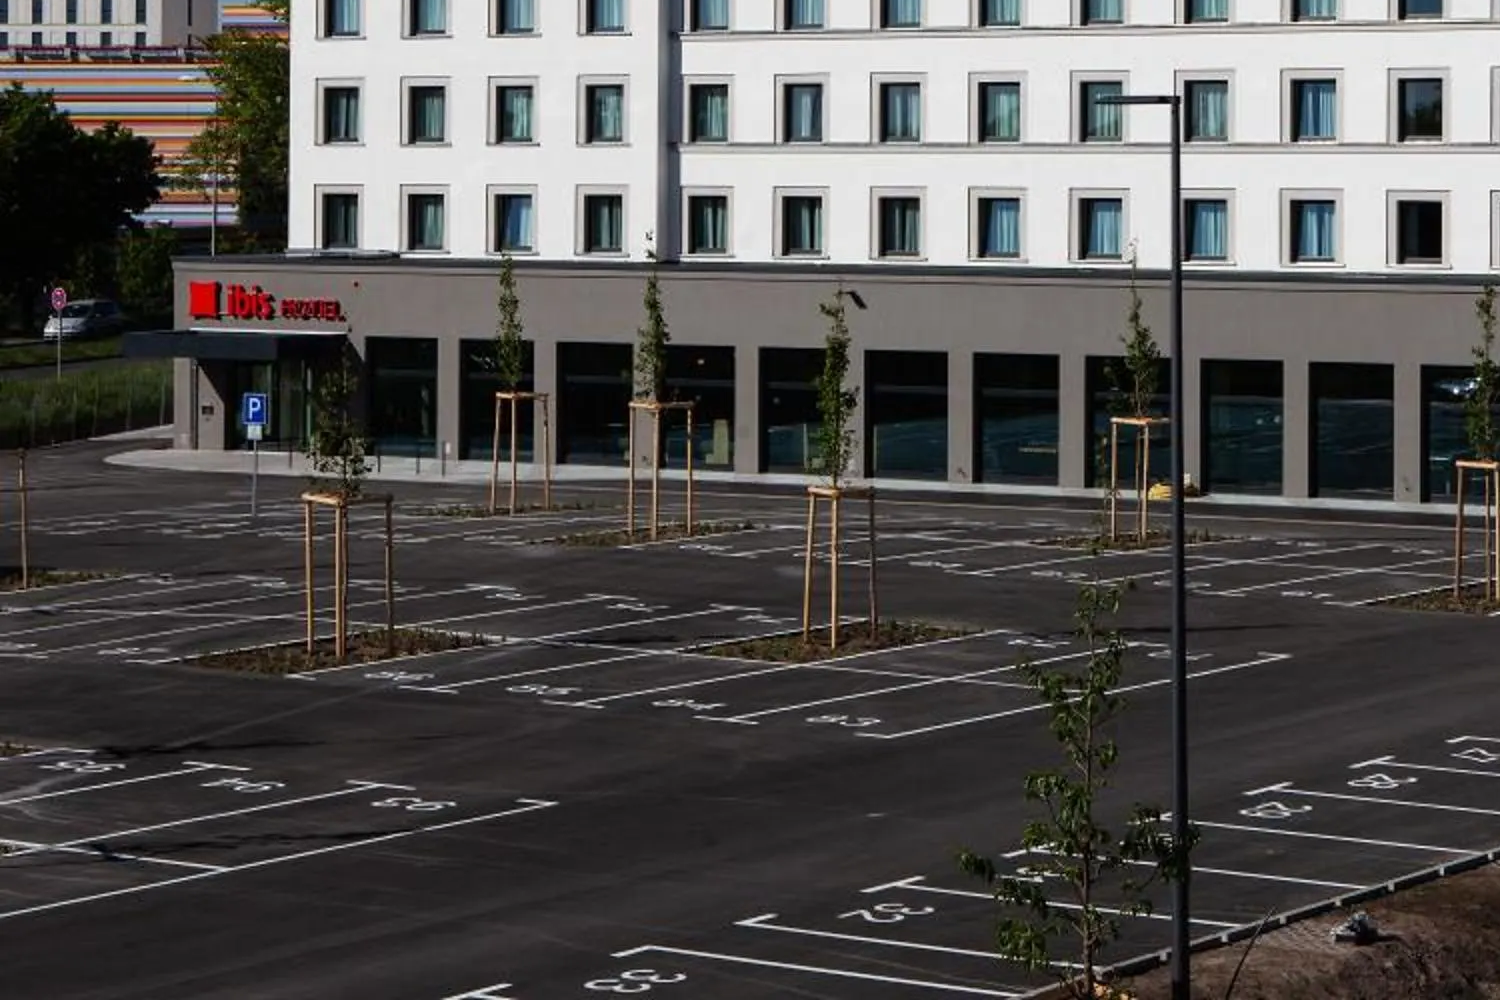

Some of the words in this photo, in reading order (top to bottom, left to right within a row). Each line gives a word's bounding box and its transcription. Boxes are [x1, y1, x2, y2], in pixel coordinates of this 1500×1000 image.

[227, 284, 274, 320] ibis
[281, 297, 342, 322] HOTEL
[249, 397, 261, 420] P
